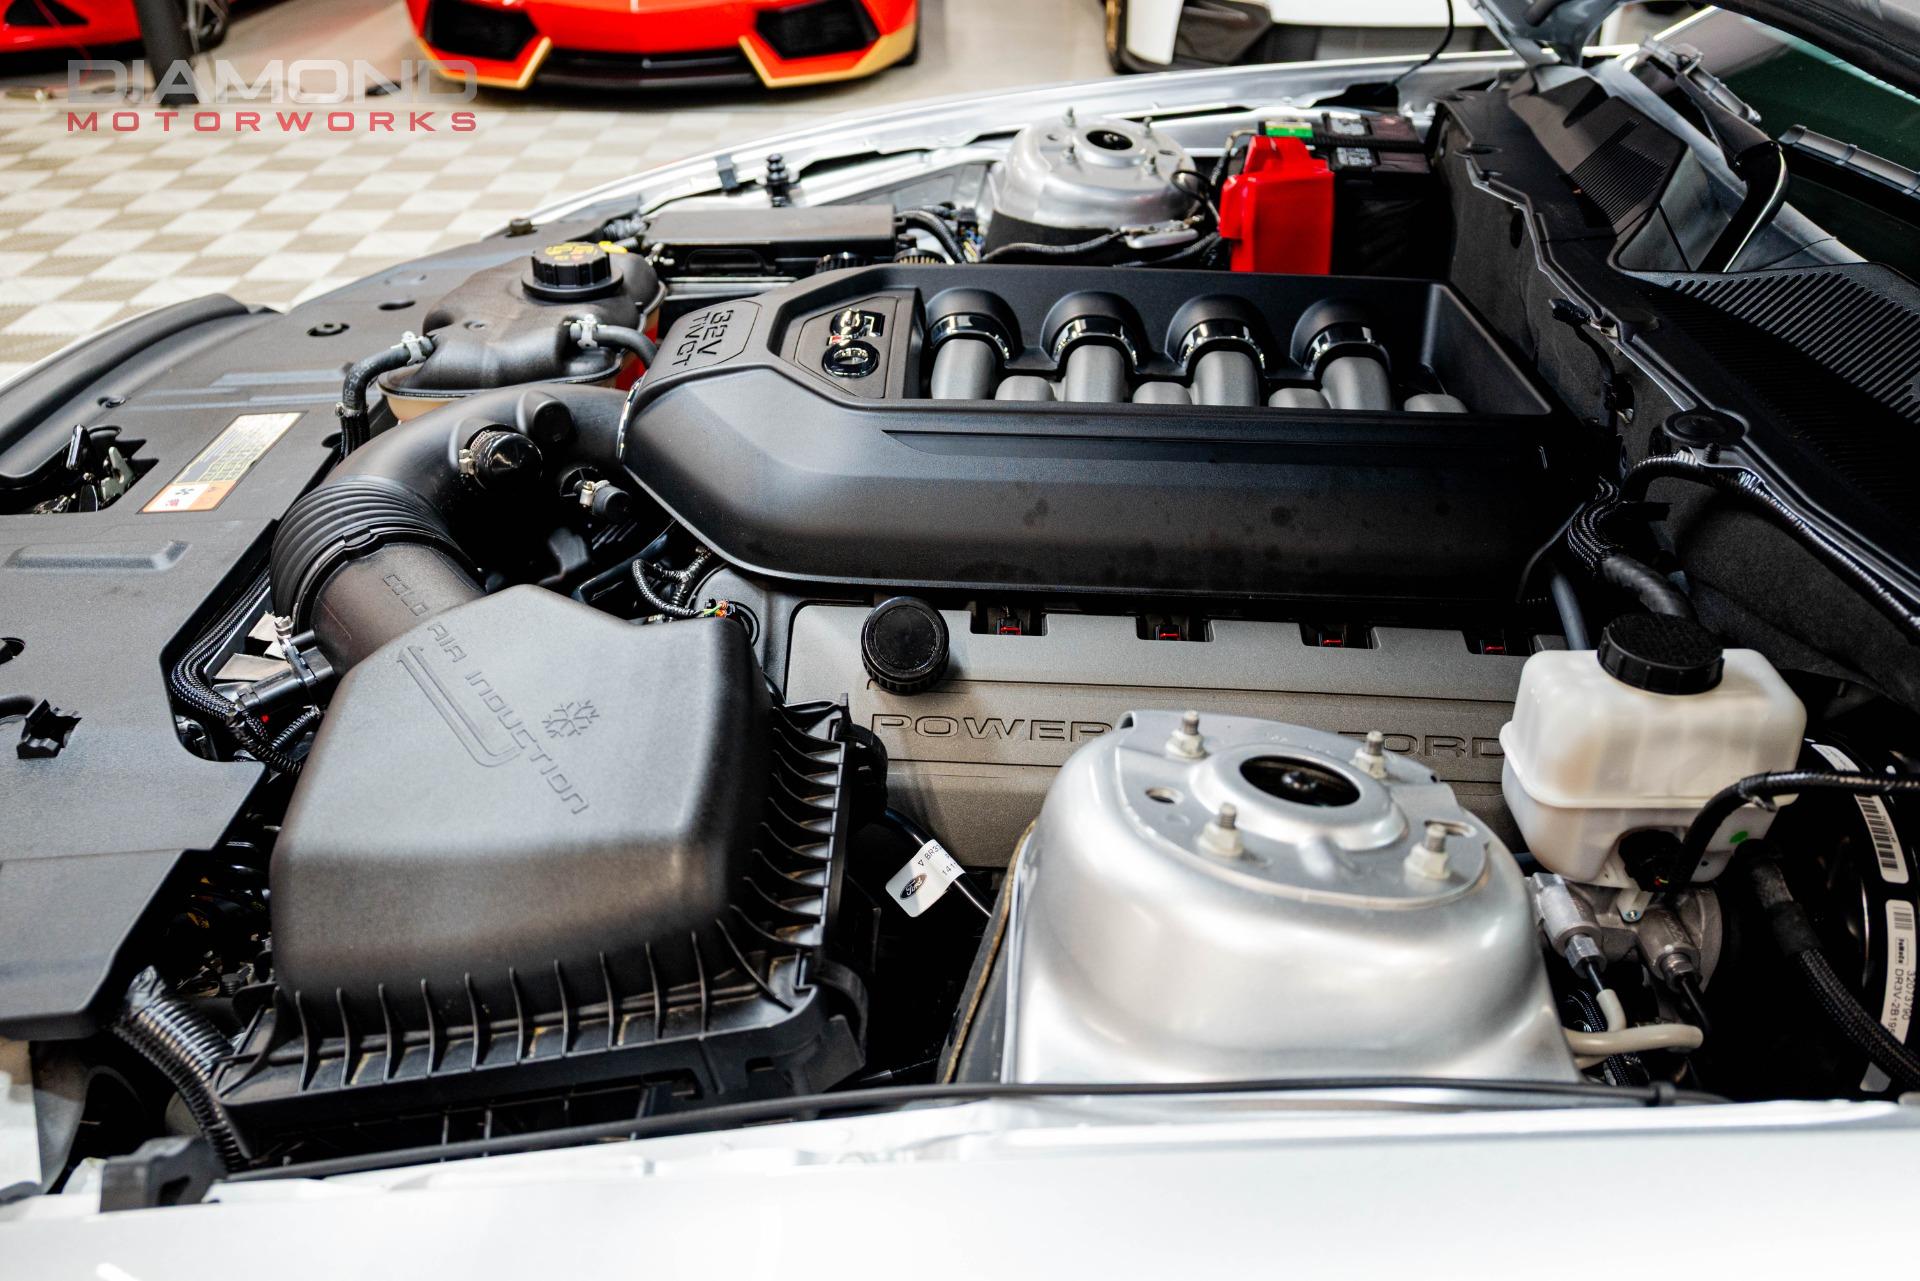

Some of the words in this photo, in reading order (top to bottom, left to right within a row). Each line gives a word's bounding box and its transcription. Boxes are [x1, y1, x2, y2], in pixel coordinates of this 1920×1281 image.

[697, 310, 734, 355] 32V
[383, 573, 428, 617] COLD
[427, 621, 467, 663] AIR
[871, 714, 1113, 743] POWER
[1337, 730, 1506, 759] ORD
